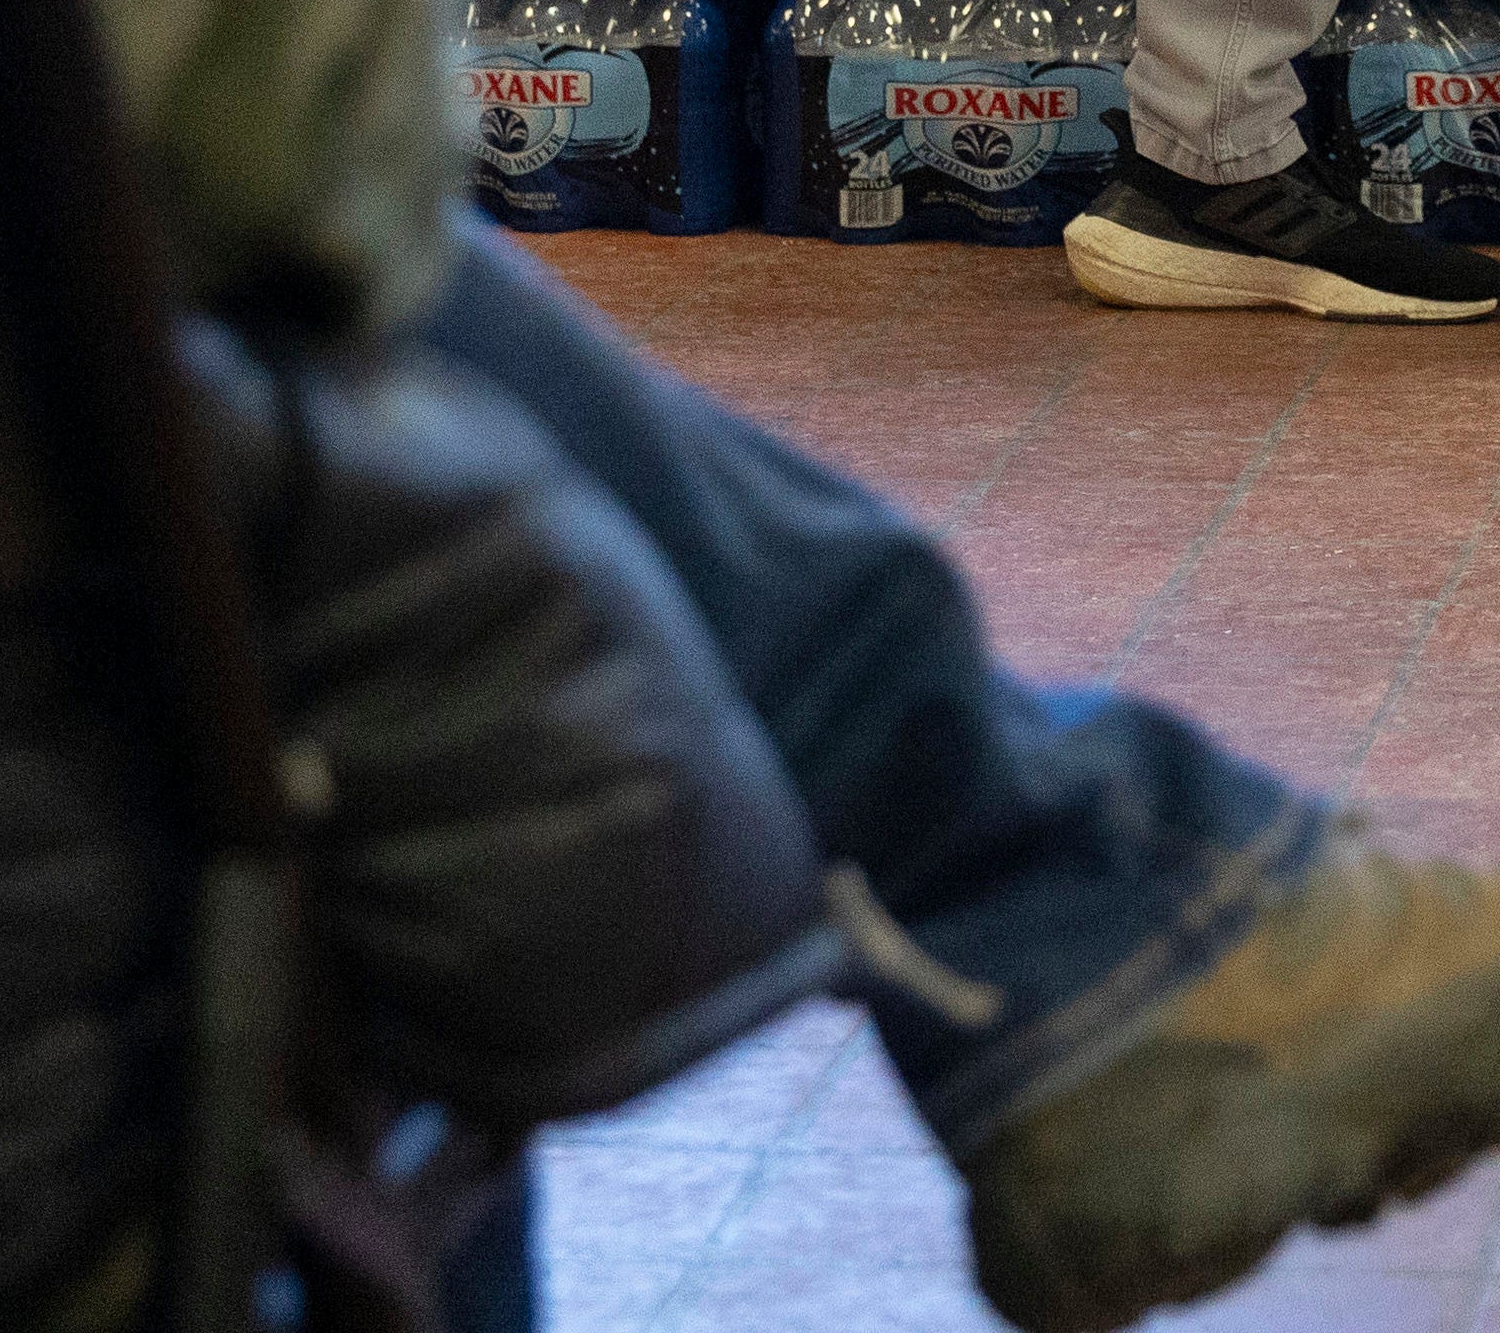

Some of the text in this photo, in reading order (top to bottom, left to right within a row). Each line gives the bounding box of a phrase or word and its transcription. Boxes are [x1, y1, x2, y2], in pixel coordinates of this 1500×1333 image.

[470, 73, 583, 103] XANE
[893, 85, 1070, 118] ROXANE
[850, 151, 891, 179] 24
[990, 147, 1046, 188] WATER
[1371, 143, 1412, 172] 24
